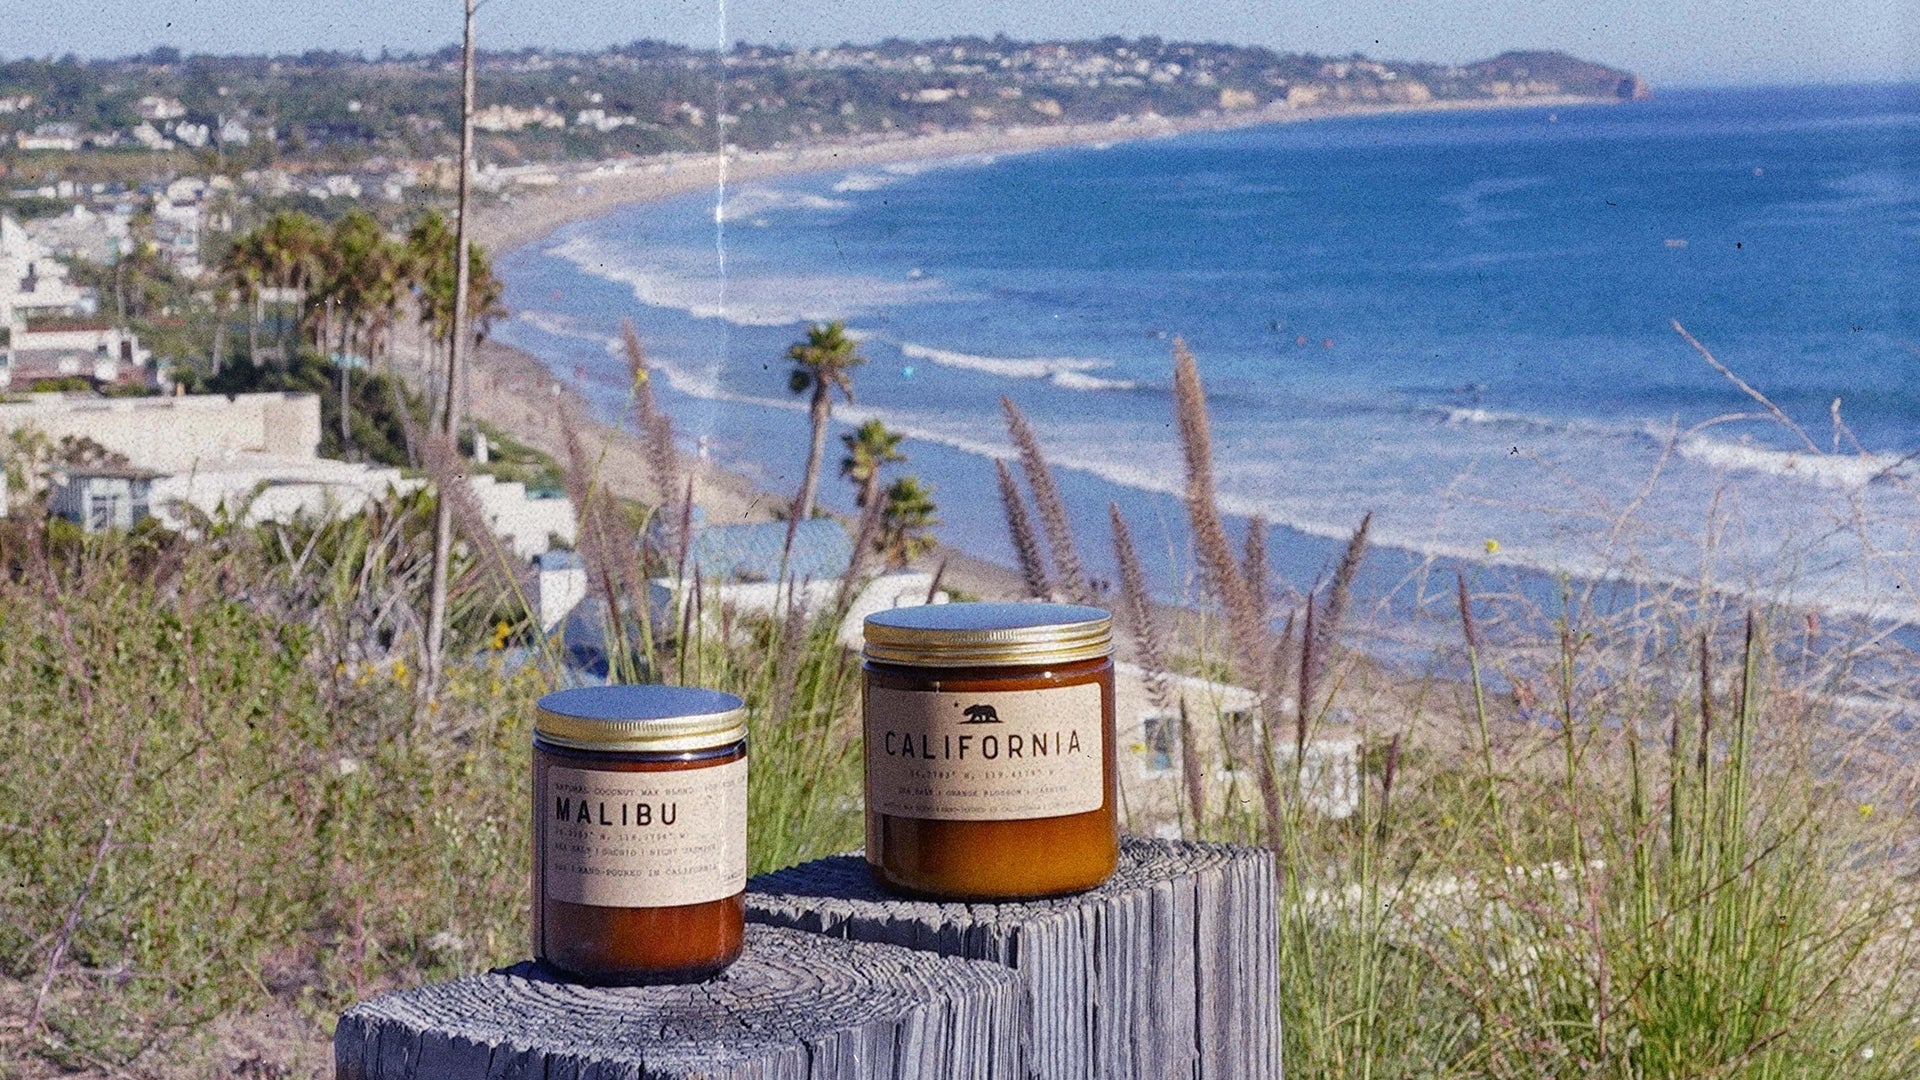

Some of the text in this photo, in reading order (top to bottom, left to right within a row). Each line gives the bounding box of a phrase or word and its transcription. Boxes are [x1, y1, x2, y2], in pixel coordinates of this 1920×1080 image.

[885, 730, 1081, 760] CALIFORNIA
[594, 787, 635, 797] COCONUT
[556, 796, 678, 827] MALIBU
